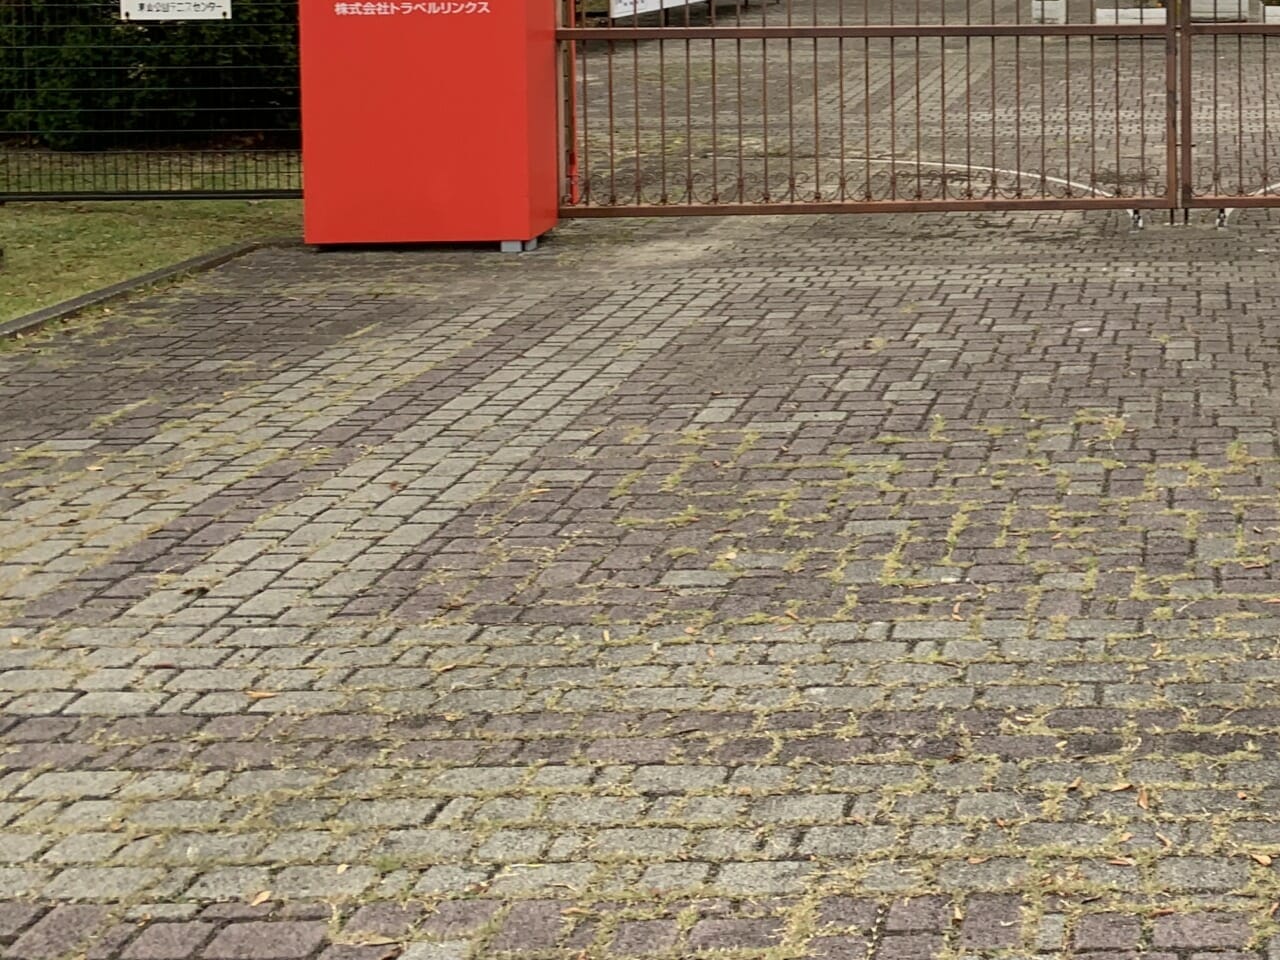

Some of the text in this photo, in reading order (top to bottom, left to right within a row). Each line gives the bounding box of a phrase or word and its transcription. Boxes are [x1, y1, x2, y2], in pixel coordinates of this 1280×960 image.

[335, 2, 490, 16] 株式会社トラベルリンクス
